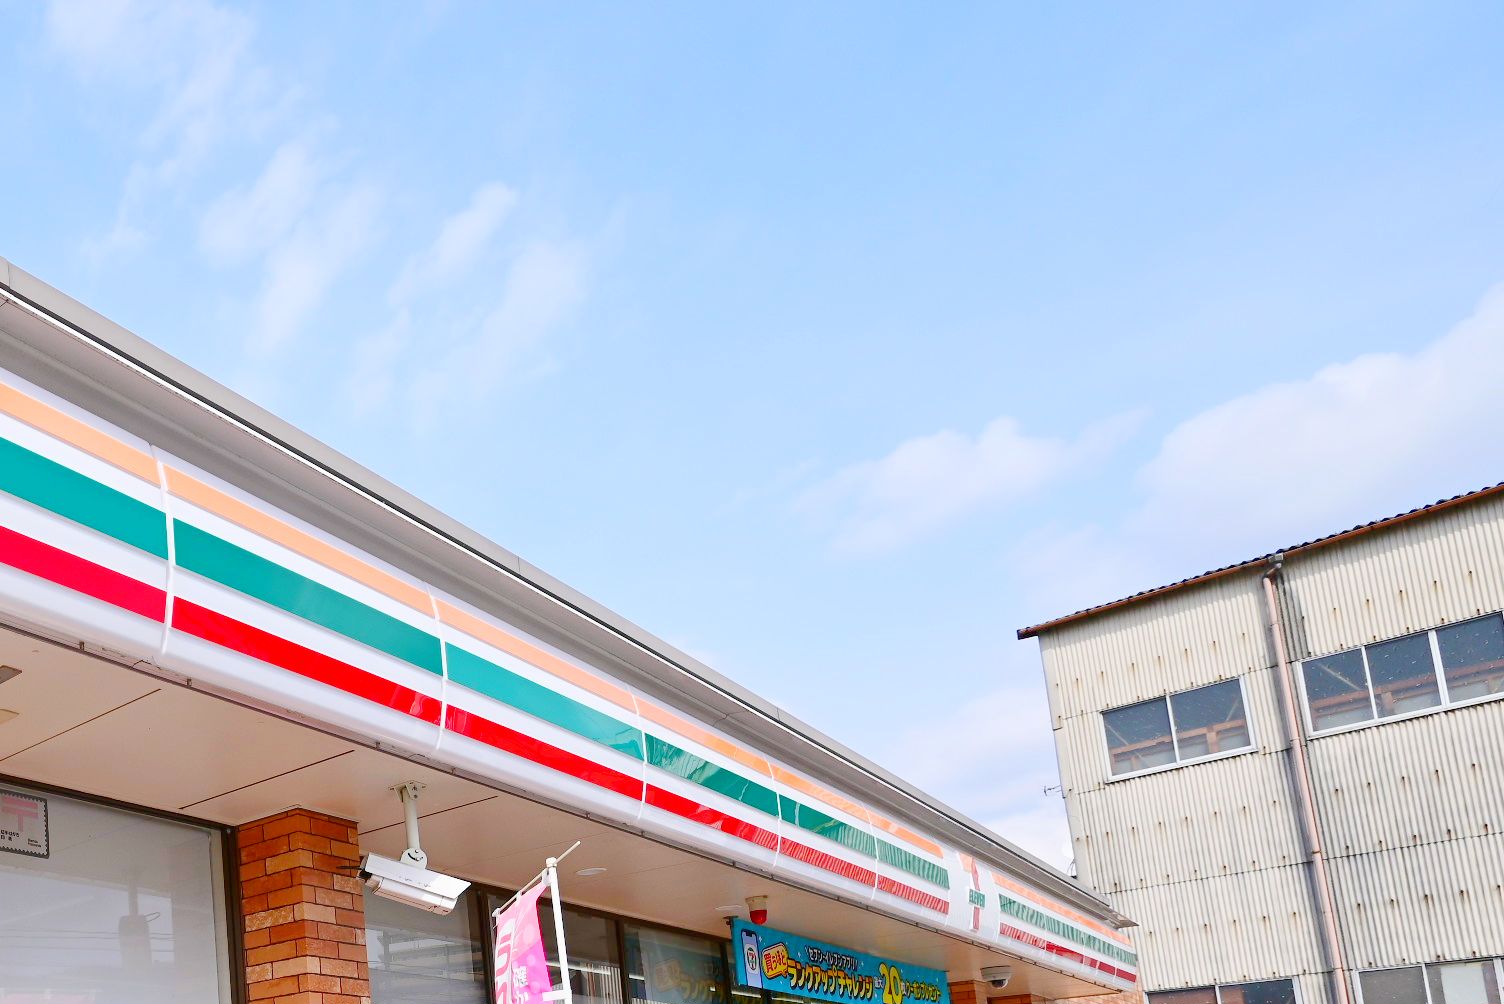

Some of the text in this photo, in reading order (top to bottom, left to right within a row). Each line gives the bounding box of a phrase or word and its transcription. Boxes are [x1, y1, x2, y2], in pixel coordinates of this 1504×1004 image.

[763, 950, 787, 974] 買うほど
[787, 959, 874, 1000] ランクアップチャレンジ
